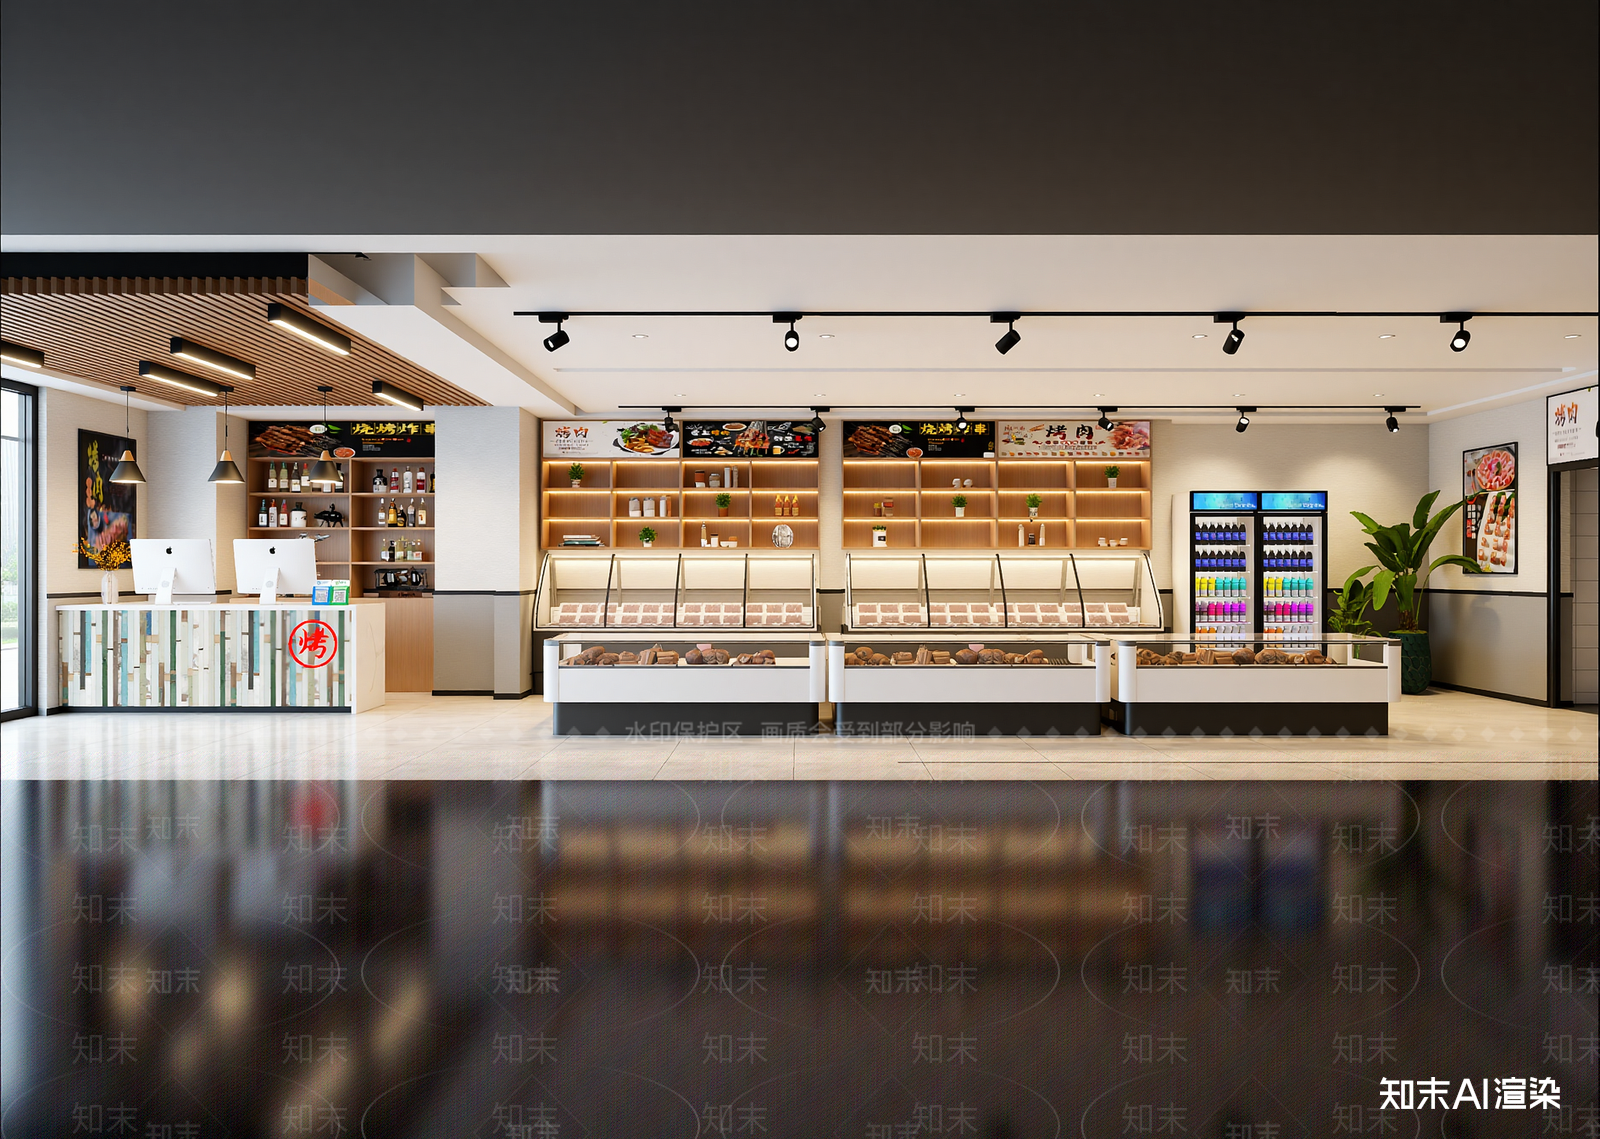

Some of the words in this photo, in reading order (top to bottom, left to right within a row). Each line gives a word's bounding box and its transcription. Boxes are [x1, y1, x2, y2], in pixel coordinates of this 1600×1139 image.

[1554, 402, 1579, 427] 烤肉
[555, 426, 589, 439] 烤肉
[1045, 423, 1094, 440] 烤肉
[298, 626, 330, 659] 烤
